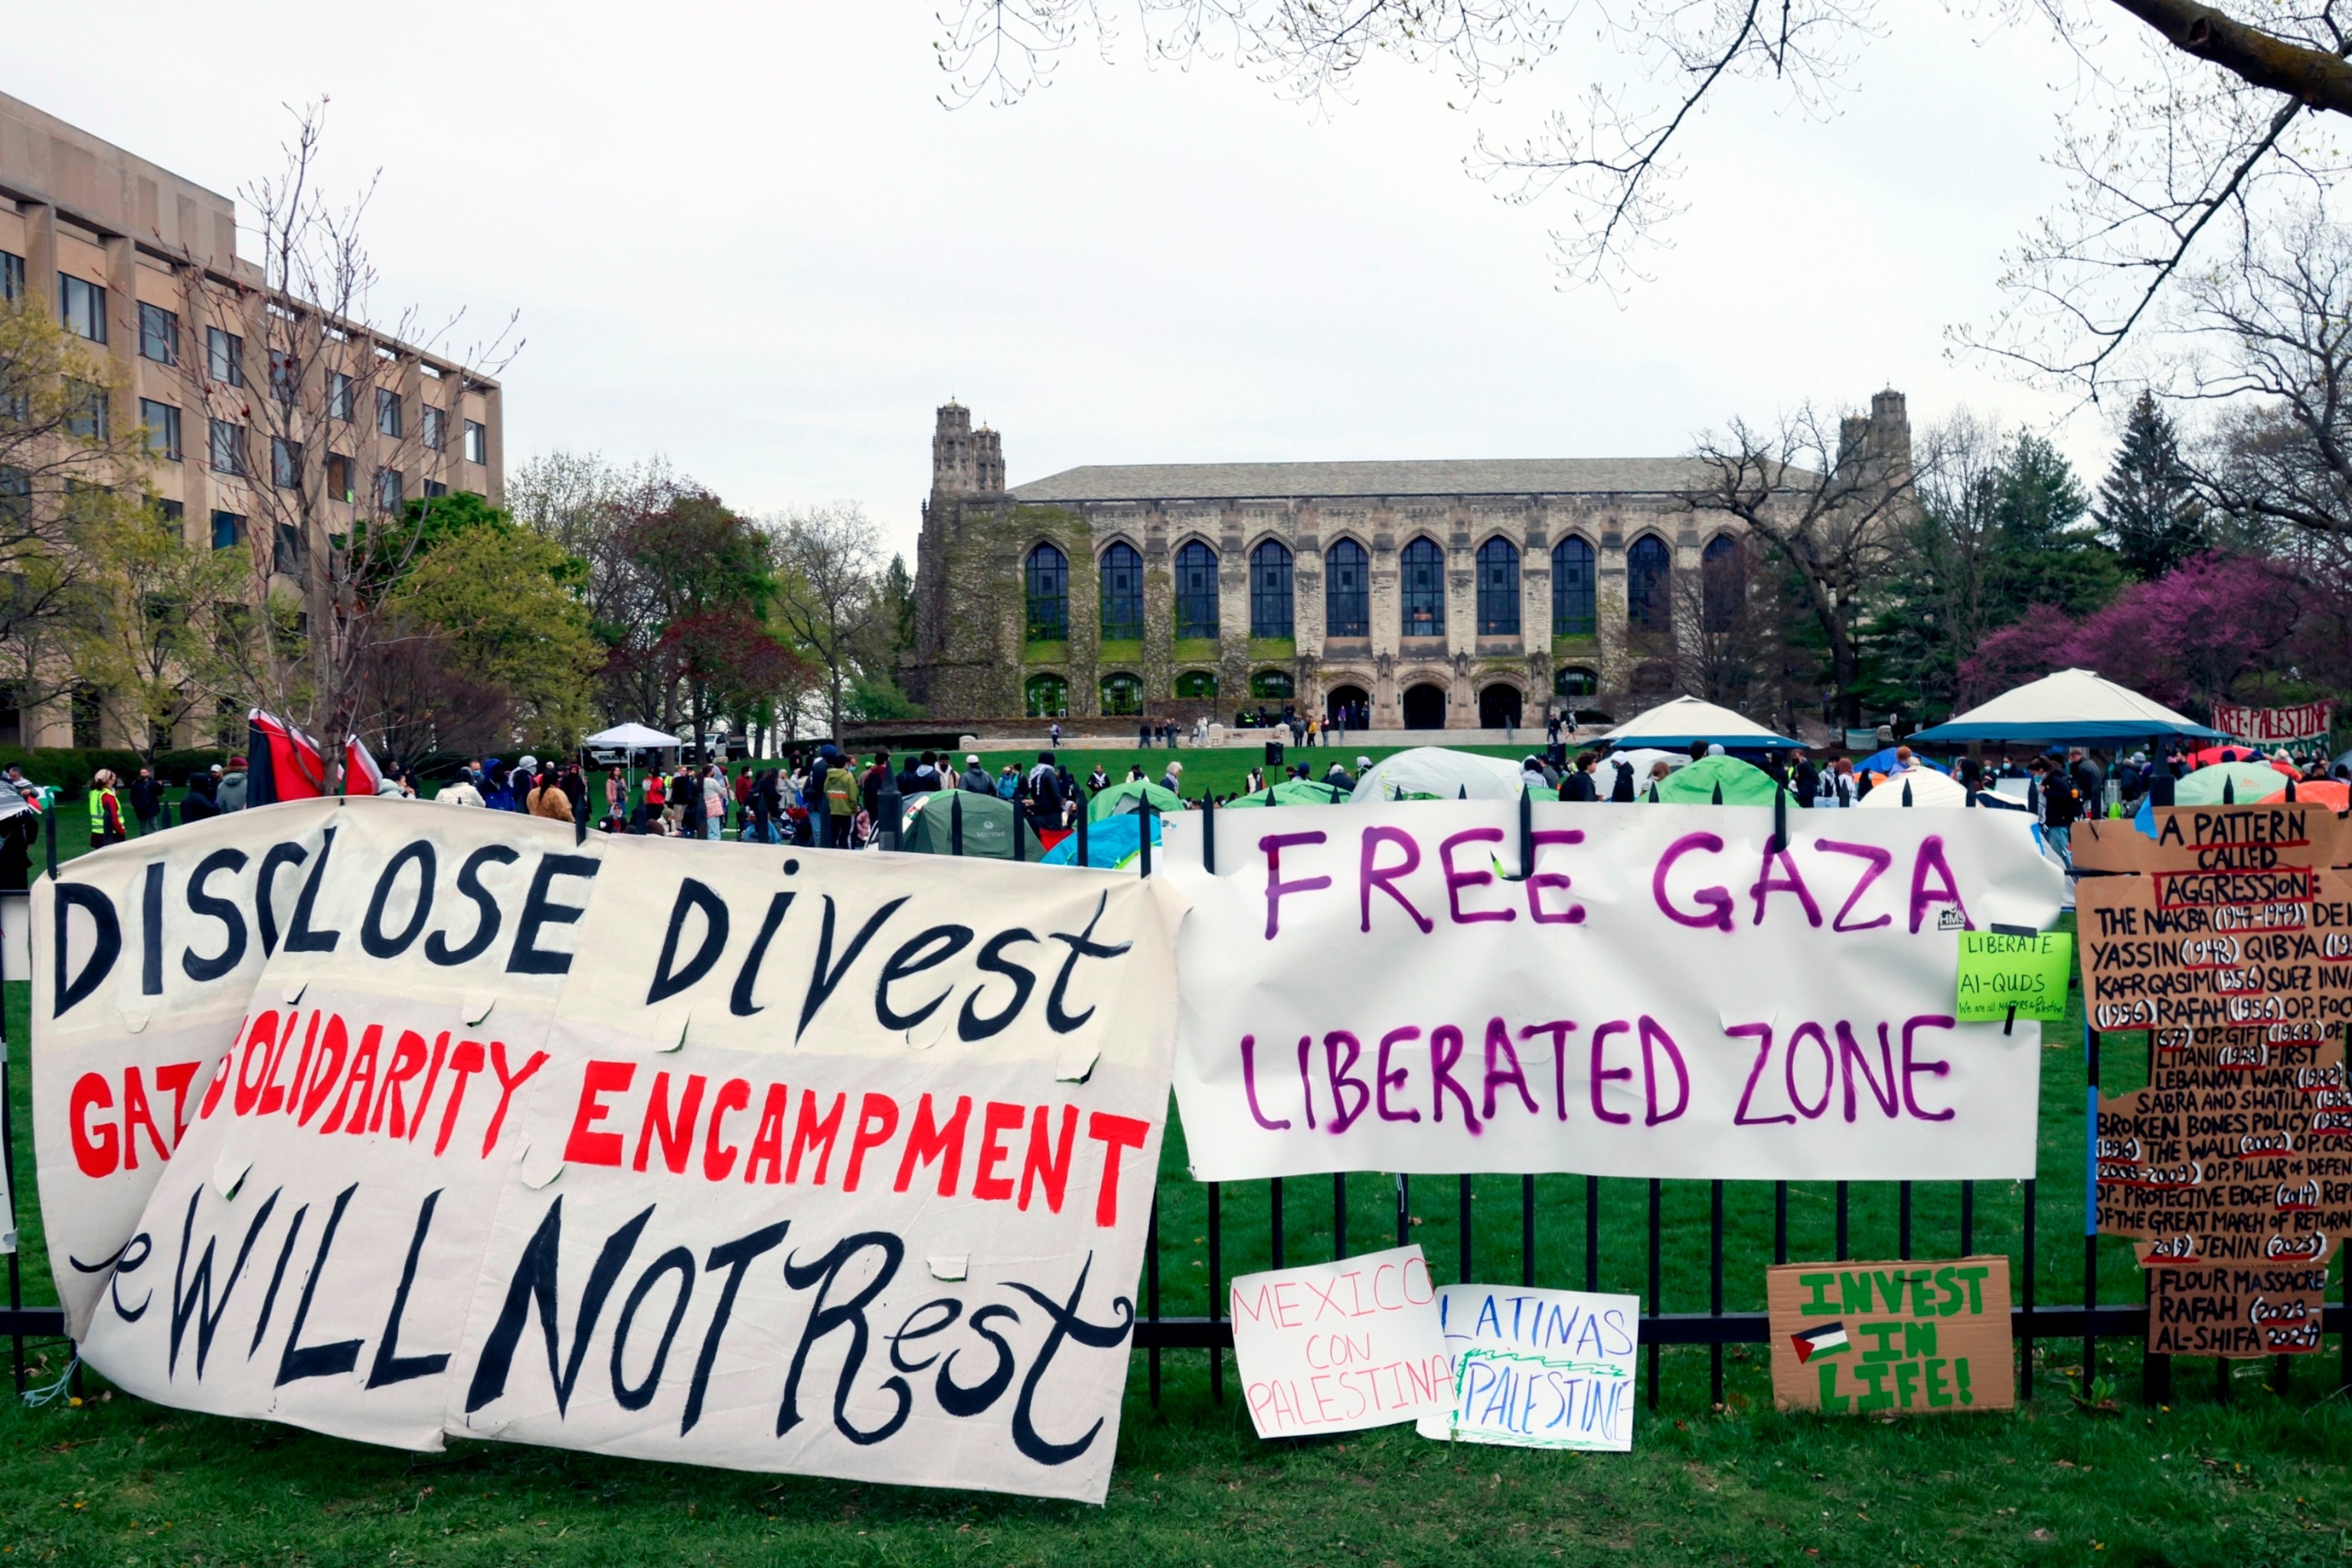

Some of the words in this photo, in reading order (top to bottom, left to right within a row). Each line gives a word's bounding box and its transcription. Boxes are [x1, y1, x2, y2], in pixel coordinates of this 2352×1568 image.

[2211, 702, 2246, 738] FREE
[2250, 700, 2331, 740] PALESTINE
[2160, 815, 2184, 846] A
[2194, 811, 2305, 846] PATTERN
[2198, 847, 2278, 871] CALLED
[1260, 826, 1586, 940] FREE
[1652, 831, 1975, 935] GAZA
[54, 826, 602, 1019] DISCLOSE
[2094, 907, 2137, 937] THE
[2144, 908, 2212, 936] NAKBA
[1968, 936, 2053, 954] LIBERATE
[2091, 939, 2178, 972] YASSIN
[2180, 936, 2239, 965] (1948)
[2244, 933, 2320, 963] QIBYA
[2096, 973, 2148, 1001] KAFR
[2148, 971, 2211, 997] QASIM
[2212, 965, 2265, 992] (1956)
[2266, 965, 2312, 992] SUEZ
[1959, 1001, 1971, 1014] We
[1998, 1000, 2028, 1011] MAYRS
[2096, 999, 2157, 1027] (1956)
[2158, 997, 2227, 1026] RAFAH
[2230, 995, 2284, 1021] (1956)
[2226, 1026, 2266, 1046] GIFT
[2267, 1020, 2324, 1044] (1968)
[2157, 1047, 2216, 1069] LITANI
[2268, 1045, 2320, 1067] FIRST
[1240, 1013, 1690, 1135] LIBERATED
[1723, 1014, 1956, 1125] ZONE
[2155, 1069, 2243, 1090] LEBANON
[2251, 1069, 2295, 1090] WAR
[2297, 1060, 2343, 1089] (1982)
[2135, 1090, 2198, 1114] SABRA
[2201, 1091, 2236, 1111] AND
[2240, 1090, 2312, 1112] SHATILA
[2097, 1112, 2180, 1140] BROKEN
[2187, 1113, 2248, 1138] BONES
[2252, 1111, 2311, 1134] POLICY
[564, 1060, 1151, 1227] ENCAMPMENT
[2143, 1140, 2181, 1164] THE
[2186, 1138, 2239, 1159] WALL
[2239, 1132, 2292, 1154] (2002)
[2233, 1158, 2286, 1182] PILLAR
[2125, 1186, 2226, 1209] PROTECTIVE
[2229, 1184, 2273, 1207] EDGE
[2276, 1179, 2320, 1206] (2014)
[2115, 1210, 2145, 1230] THE
[2148, 1210, 2209, 1235] GREAT
[2212, 1211, 2265, 1233] MARCH
[2269, 1210, 2292, 1233] OF
[2294, 1210, 2352, 1233] RETURN
[2195, 1234, 2261, 1260] JENIN
[2265, 1231, 2327, 1262] (2023)
[1231, 1258, 1435, 1334] MEXICO
[1799, 1266, 1988, 1318] INVEST
[2159, 1268, 2230, 1295] FLOUR
[170, 1182, 451, 1390] WILL
[466, 1194, 791, 1438] NOT
[777, 1231, 1135, 1465] Rest
[2159, 1295, 2237, 1324] RAFAH
[1442, 1294, 1633, 1358] LATINAS
[1859, 1321, 1937, 1363] IN
[2156, 1325, 2261, 1351] AL-SHIFA
[1306, 1332, 1370, 1370] CON
[1247, 1354, 1459, 1433] PALESTINA
[1465, 1361, 1635, 1441] PALESTINE
[1818, 1357, 1974, 1413] LIFE!
